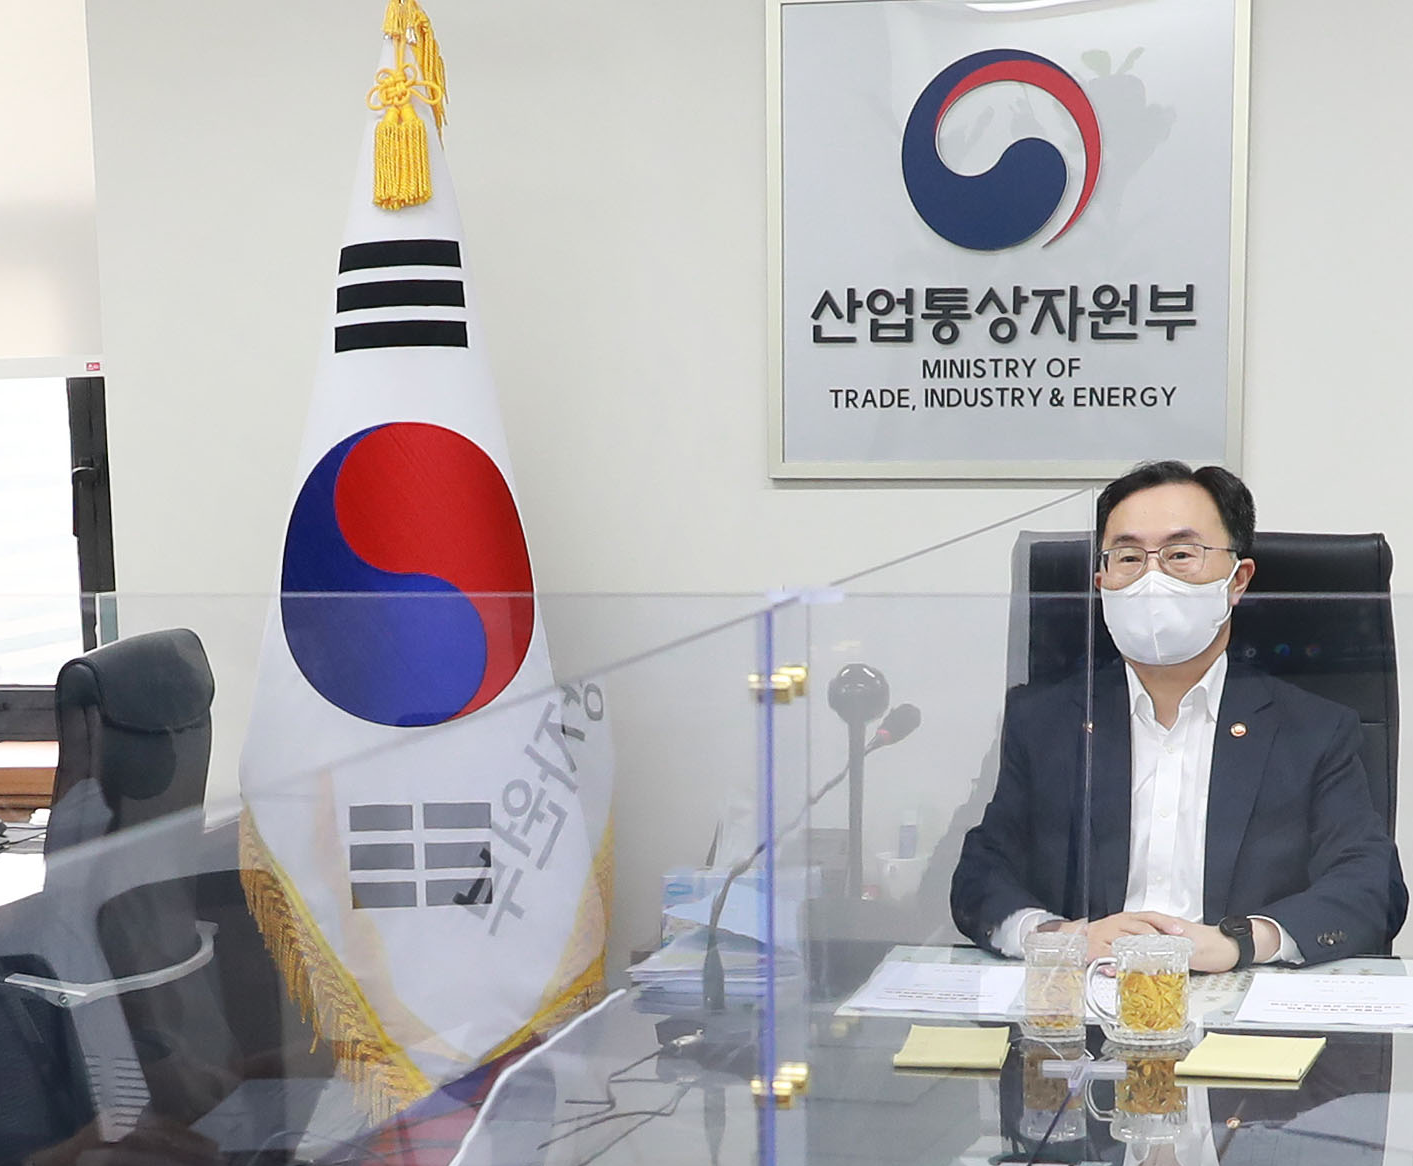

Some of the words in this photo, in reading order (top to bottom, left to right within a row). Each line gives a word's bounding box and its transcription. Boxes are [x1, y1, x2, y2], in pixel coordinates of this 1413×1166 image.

[809, 284, 1197, 345] 산업통상자원부
[921, 358, 1036, 379] MINISTRY
[1046, 358, 1081, 378] OF
[829, 389, 916, 411] TRADE,
[924, 387, 1043, 408] INDUSTRY
[1049, 387, 1065, 407] &
[1073, 386, 1177, 407] ENERGY
